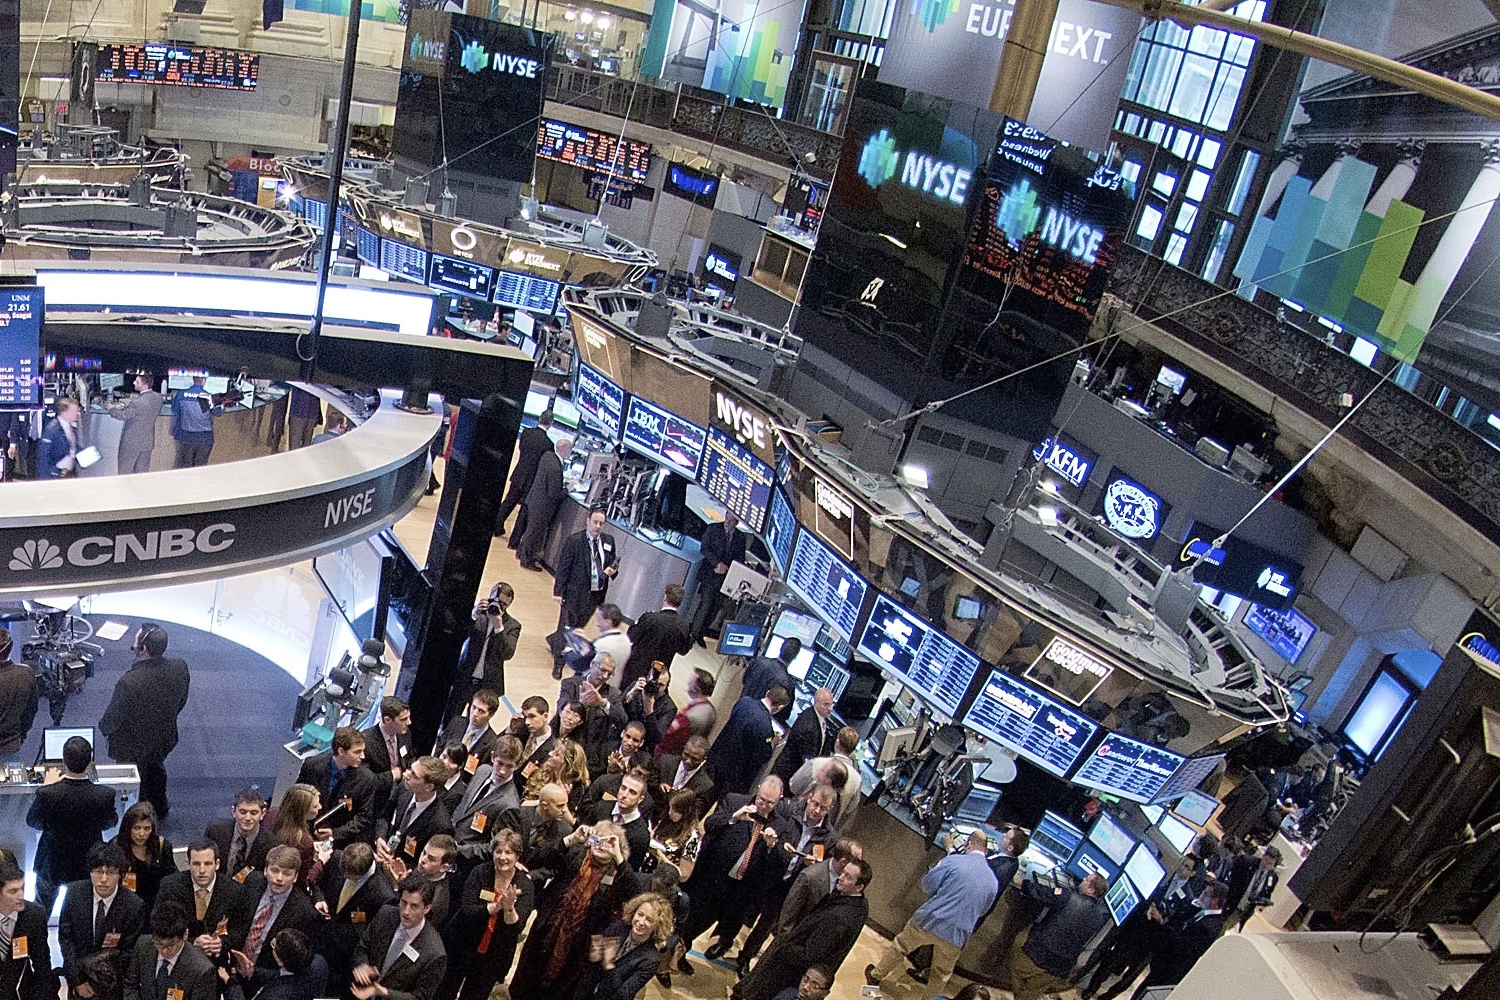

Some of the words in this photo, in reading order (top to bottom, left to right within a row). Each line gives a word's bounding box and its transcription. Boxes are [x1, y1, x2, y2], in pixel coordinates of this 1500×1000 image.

[423, 40, 444, 60] NYSE
[965, 3, 1112, 64] EUREXT
[492, 52, 537, 79] NYSE
[901, 149, 973, 205] NYSE
[1040, 206, 1104, 264] NYSE
[453, 250, 473, 259] GETCO
[8, 303, 30, 311] 21.61
[603, 411, 619, 430] PNC
[631, 407, 661, 435] IBM
[716, 391, 766, 449] NYSE
[1048, 444, 1088, 483] KFM
[324, 488, 376, 528] NYSE
[67, 523, 236, 567] CNBC
[1045, 650, 1085, 676] Sachs
[1050, 641, 1107, 678] Goldman
